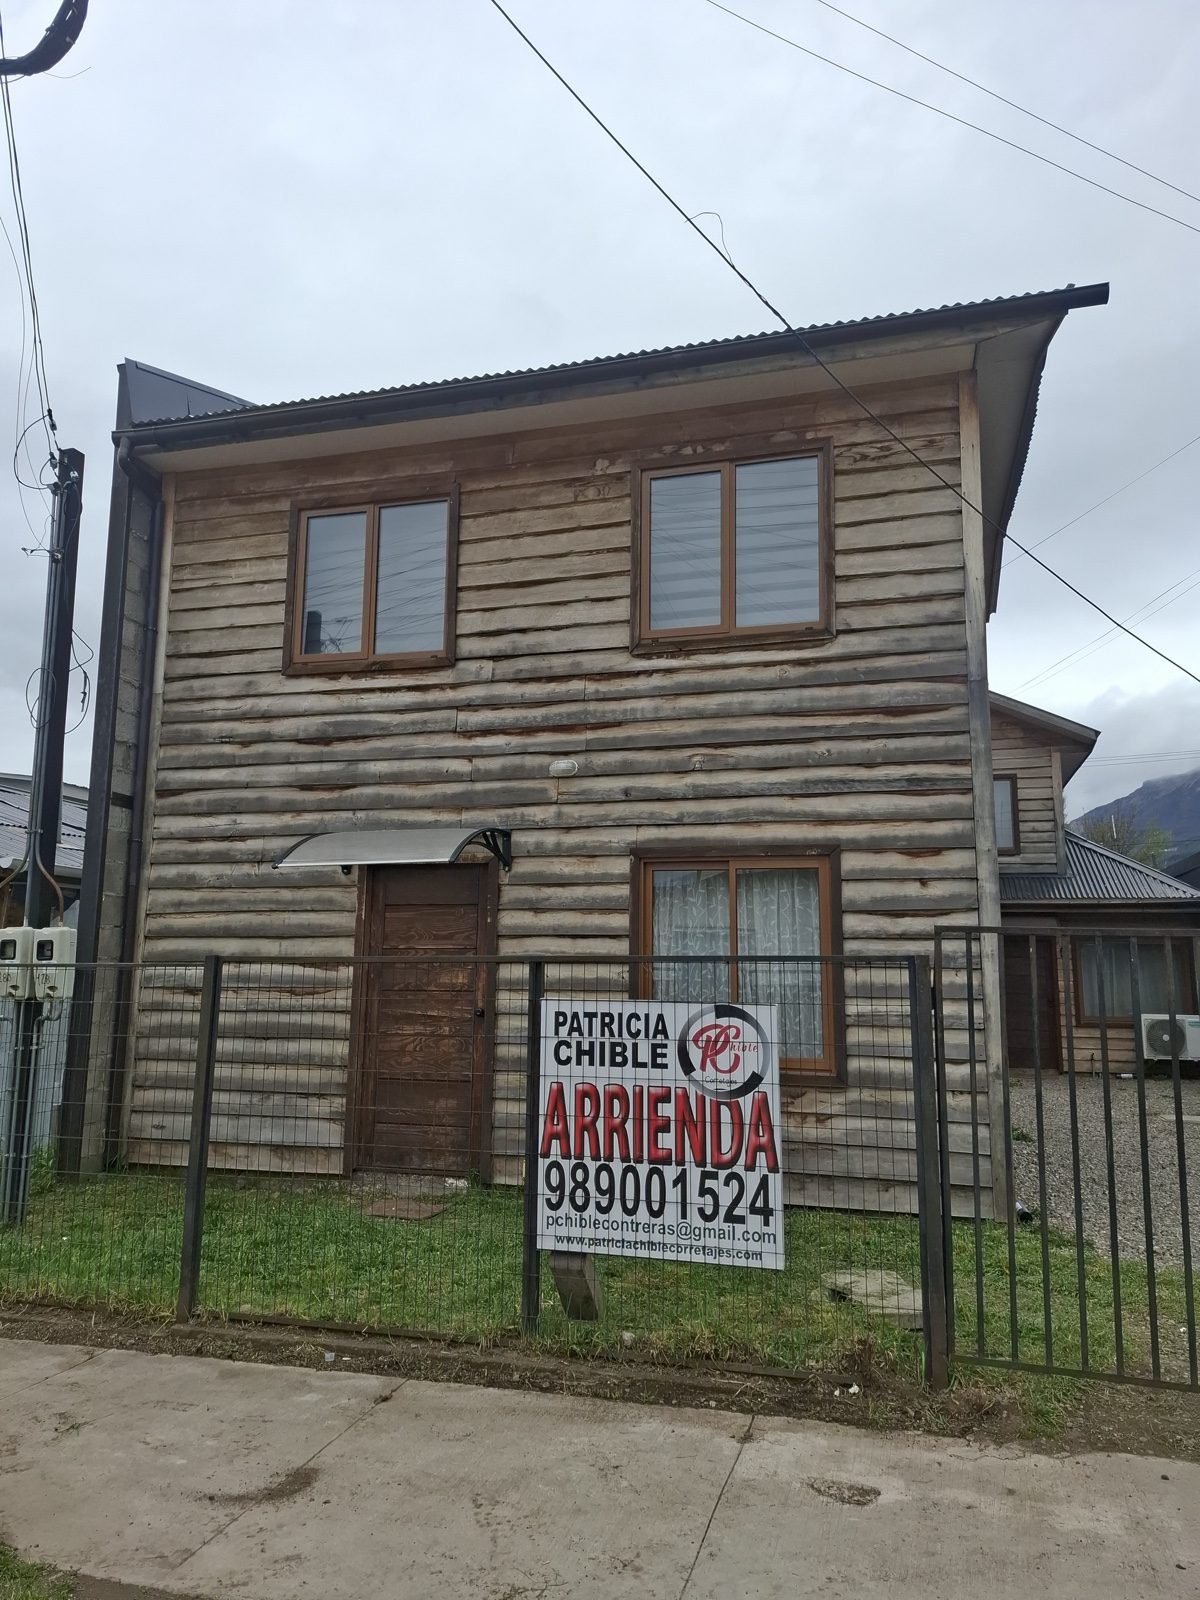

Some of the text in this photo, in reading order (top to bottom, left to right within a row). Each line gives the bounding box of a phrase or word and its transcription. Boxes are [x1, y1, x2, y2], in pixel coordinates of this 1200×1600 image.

[554, 1011, 669, 1039] PATRICIA
[554, 1041, 669, 1069] CHIBLE
[540, 1082, 779, 1173] ARRIENDA
[544, 1161, 774, 1227] 989001524
[546, 1213, 776, 1245] pchiblecontreras@gmail.com
[555, 1235, 763, 1262] www.patriciachiblecorretajes.com
